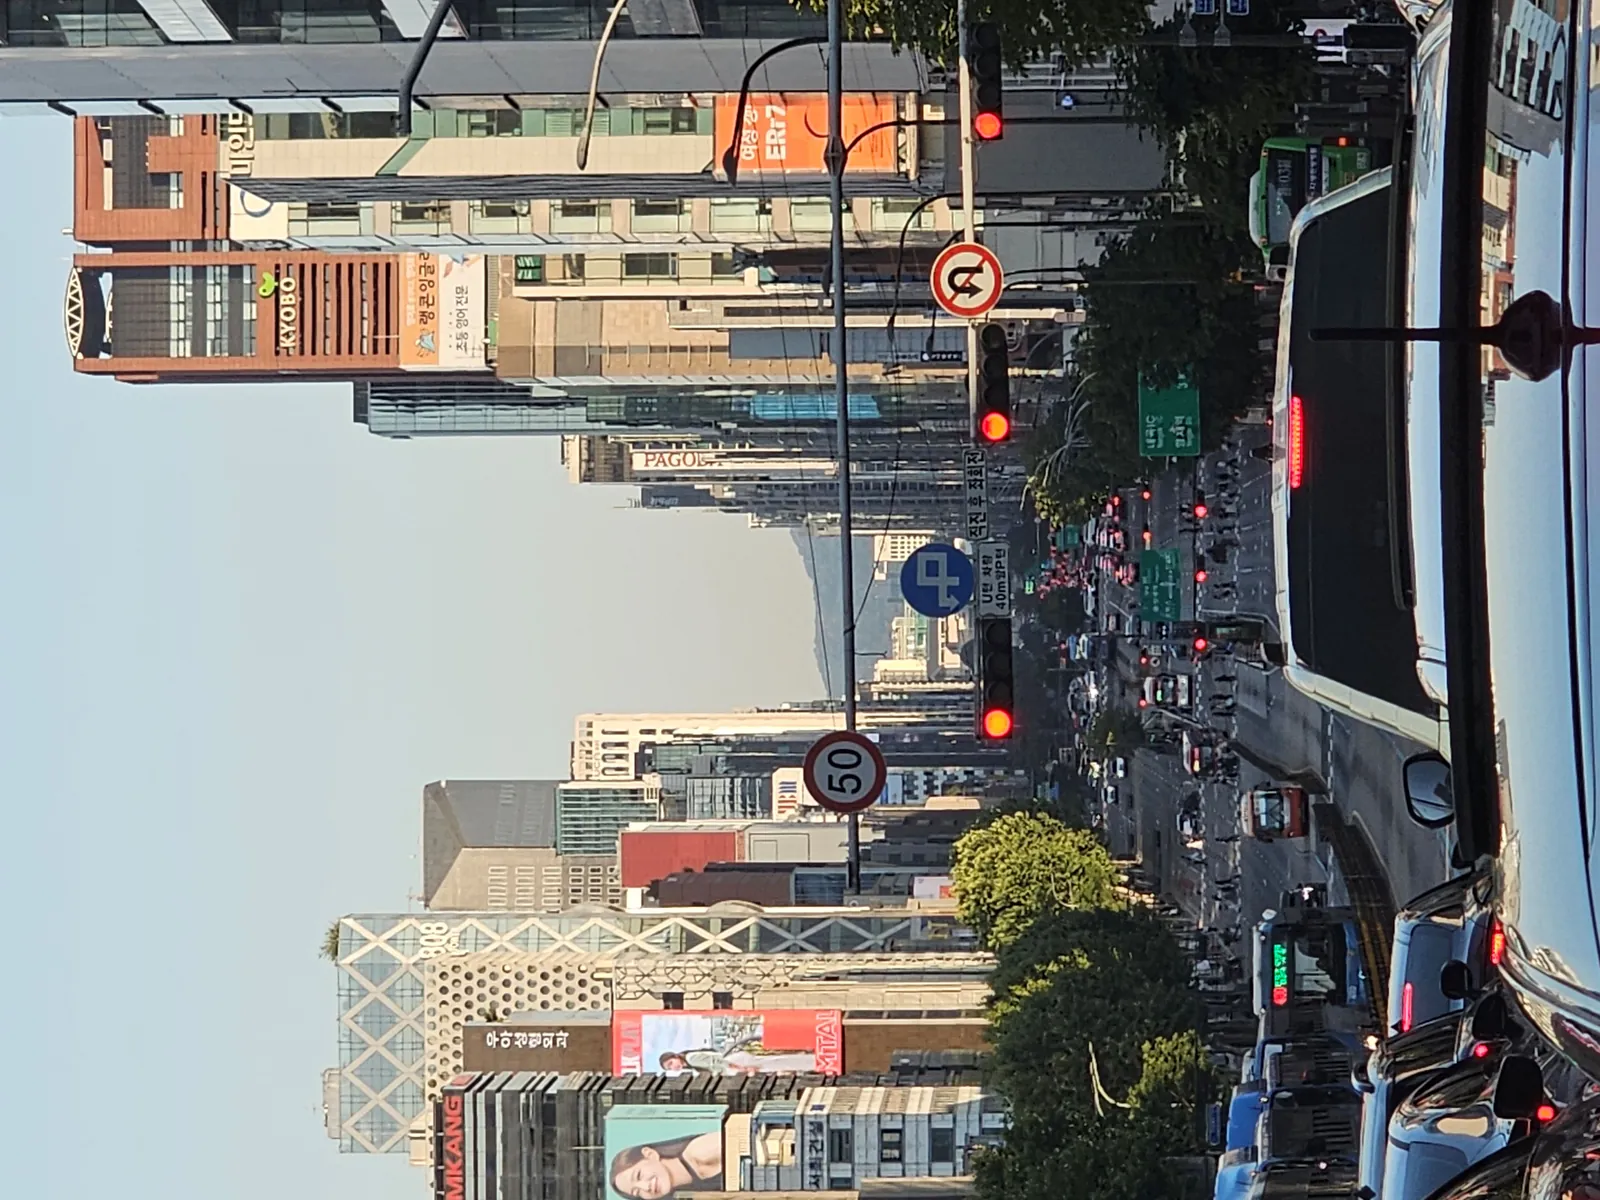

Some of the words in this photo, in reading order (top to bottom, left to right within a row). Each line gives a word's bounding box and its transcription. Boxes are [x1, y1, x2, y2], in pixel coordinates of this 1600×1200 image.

[765, 105, 787, 160] ERr7
[279, 277, 296, 347] KYOBO
[966, 451, 985, 490] 좌회전
[967, 495, 986, 508] 후
[967, 511, 986, 538] 직진
[981, 554, 993, 577] 차량
[982, 582, 993, 604] U턴
[827, 748, 862, 795] 50
[419, 922, 448, 958] 808
[486, 1031, 569, 1048] 우아성형외과
